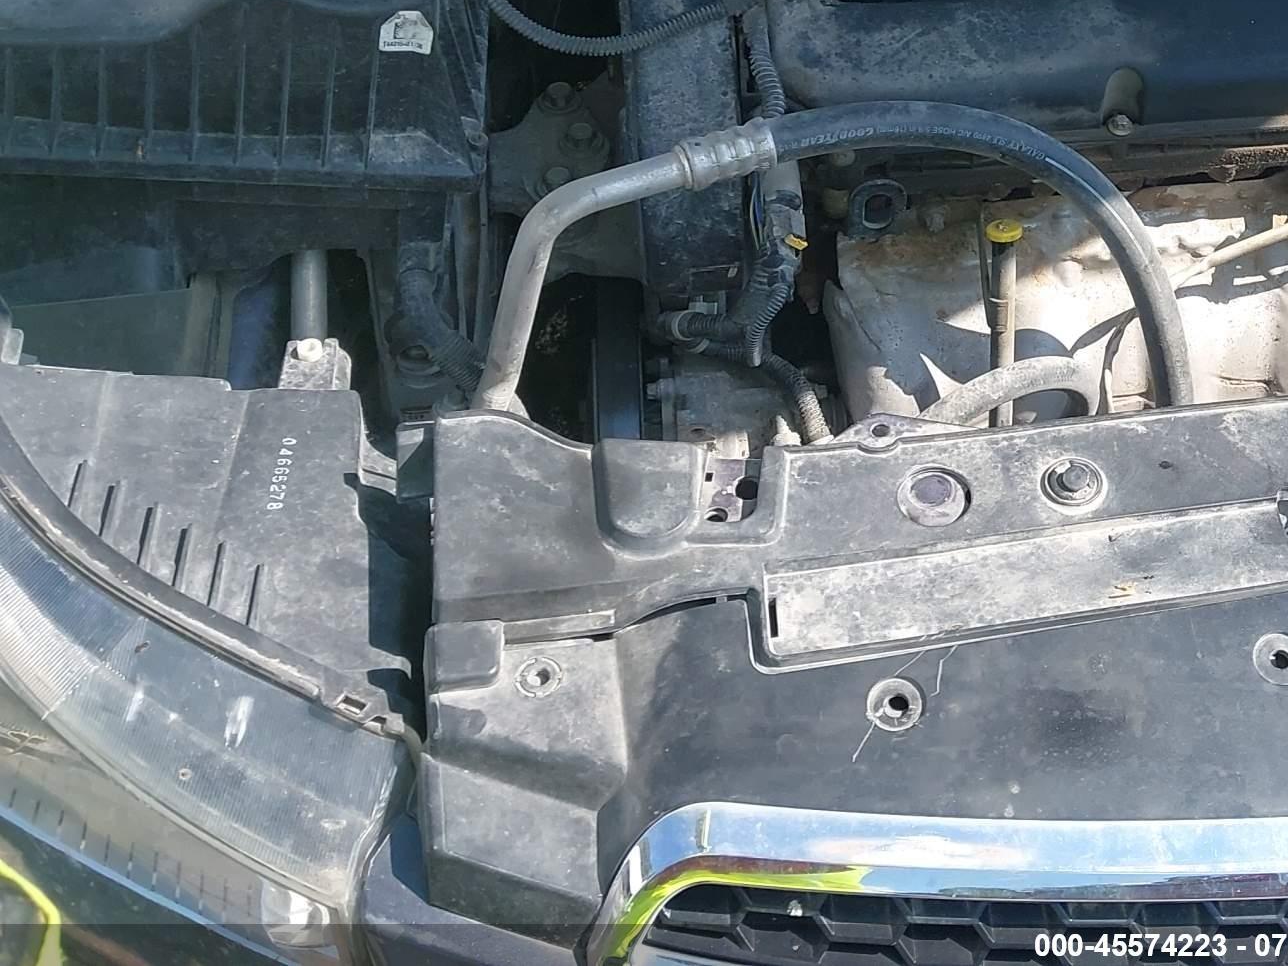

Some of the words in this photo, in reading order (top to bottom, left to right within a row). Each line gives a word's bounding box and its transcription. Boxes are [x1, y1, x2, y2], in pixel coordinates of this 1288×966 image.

[801, 127, 874, 147] GOODYEAR
[931, 125, 956, 135] HOSE
[266, 437, 297, 510] 04665278
